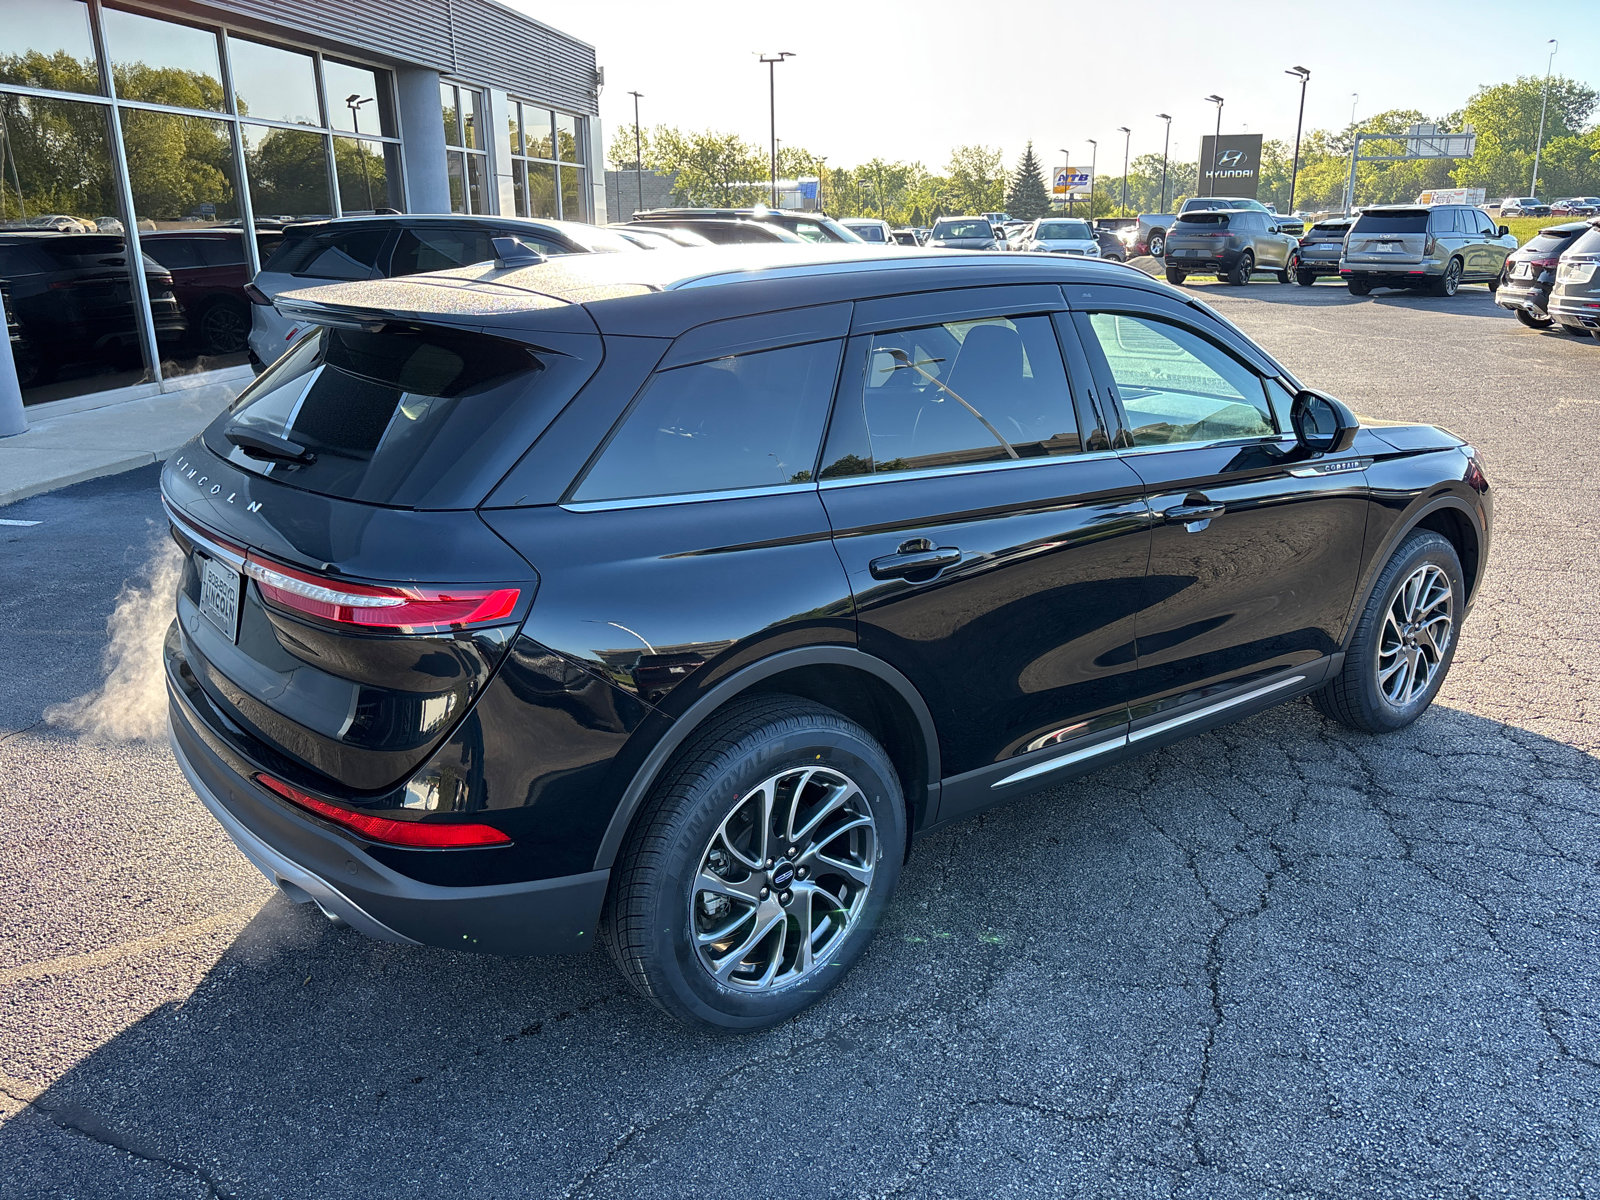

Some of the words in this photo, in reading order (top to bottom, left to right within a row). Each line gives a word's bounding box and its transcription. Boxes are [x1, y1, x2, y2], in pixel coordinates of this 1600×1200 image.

[1206, 170, 1253, 178] HYUNDAI
[176, 456, 262, 513] LINCOLN
[1325, 462, 1359, 471] CORSAIR
[206, 583, 235, 620] LINCOLN
[680, 749, 767, 848] UNIROYAL
